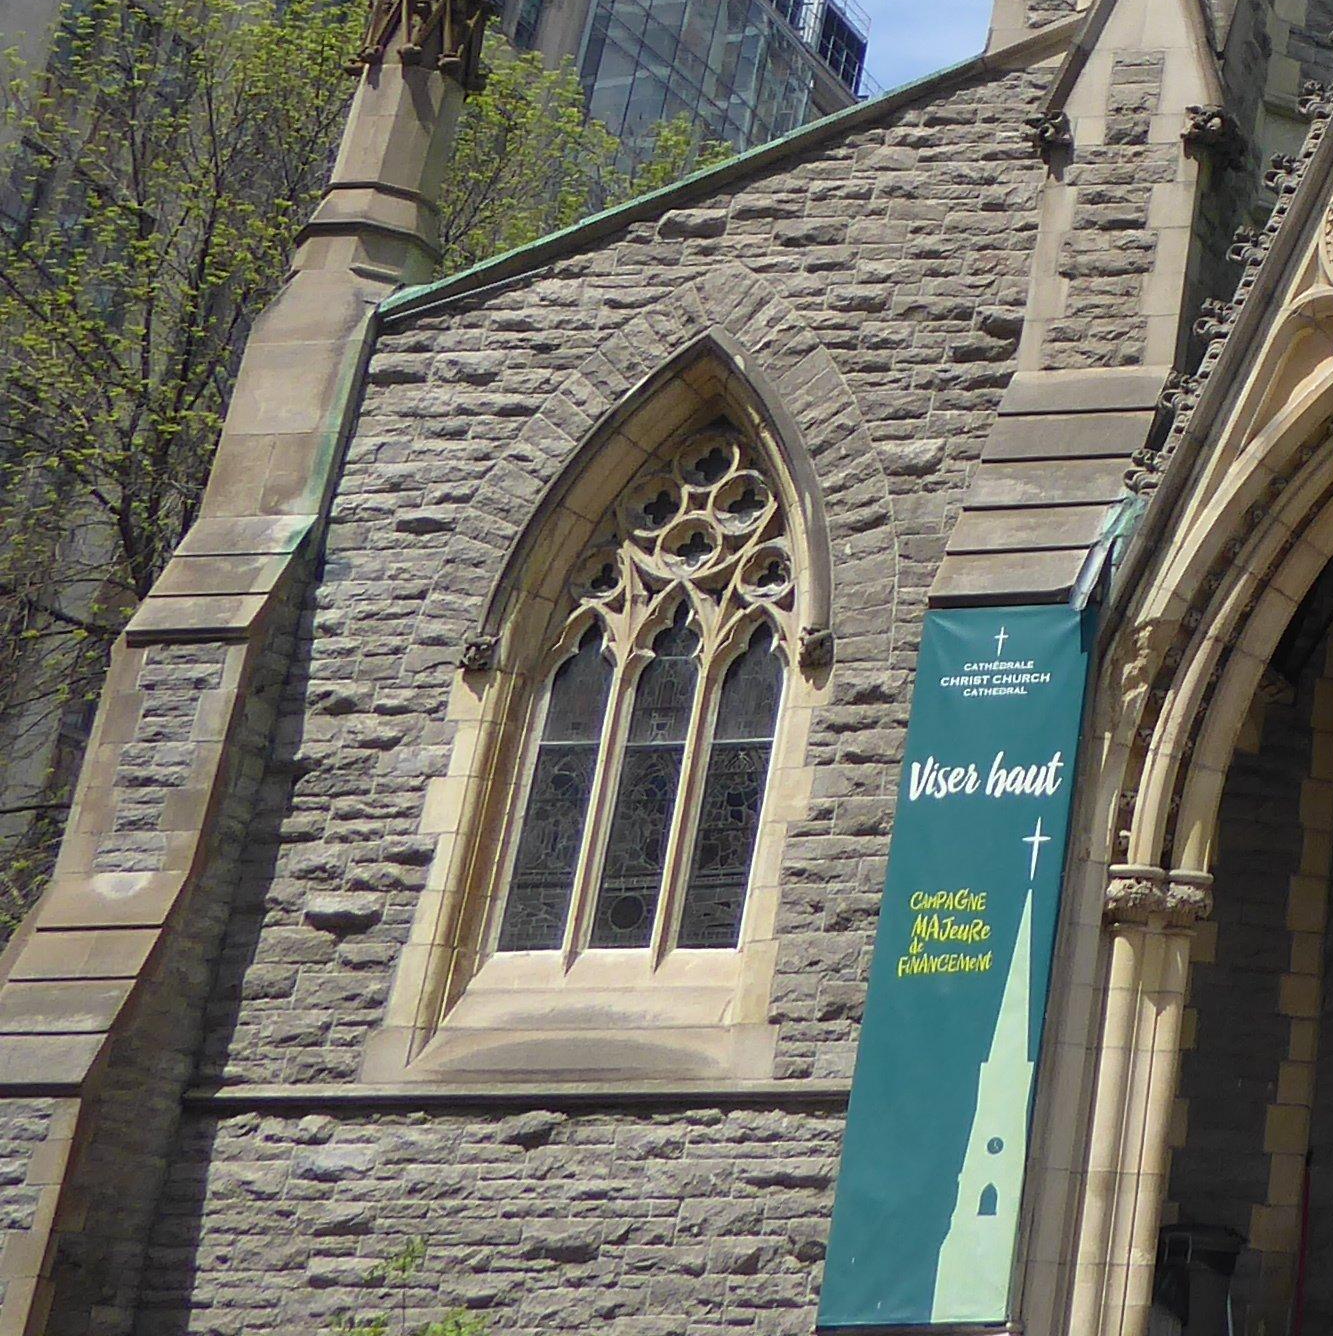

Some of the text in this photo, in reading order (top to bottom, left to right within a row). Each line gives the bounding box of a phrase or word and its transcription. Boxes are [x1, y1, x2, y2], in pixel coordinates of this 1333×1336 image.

[940, 672, 1051, 687] CHRIST CHURCH
[963, 686, 1028, 697] CATHEDRAL
[909, 751, 1064, 801] Viser haut
[909, 936, 924, 954] de
